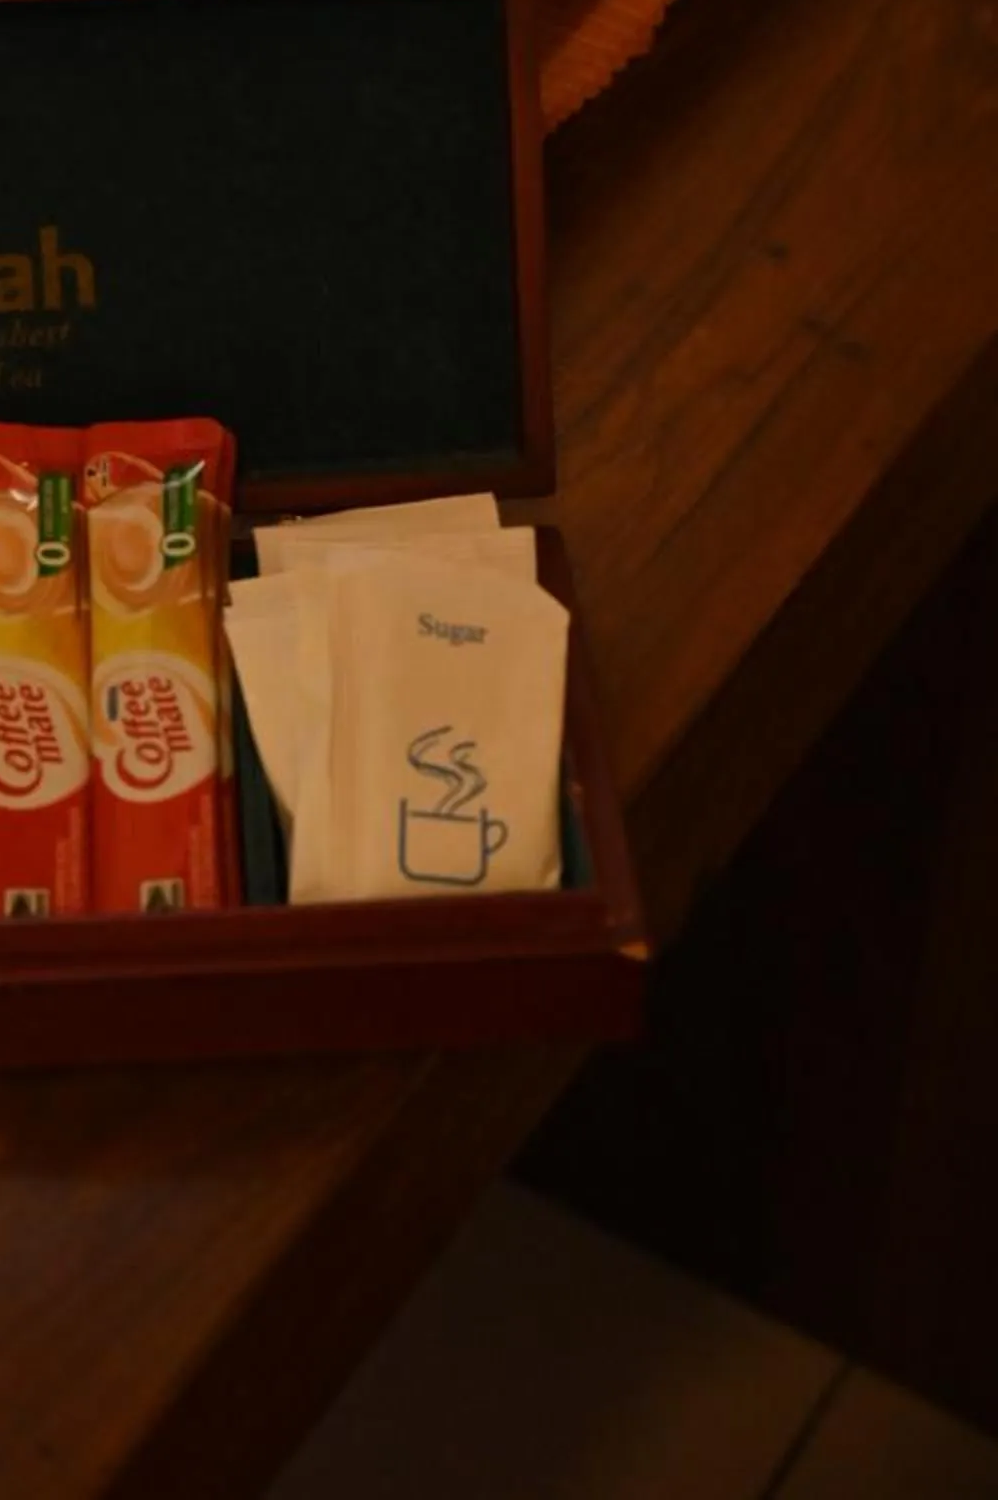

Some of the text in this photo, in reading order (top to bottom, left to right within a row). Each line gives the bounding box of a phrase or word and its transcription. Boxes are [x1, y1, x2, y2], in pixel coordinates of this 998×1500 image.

[417, 613, 489, 646] Sugar
[20, 684, 64, 765] mate
[116, 680, 173, 789] Coffee
[149, 676, 194, 753] mate
